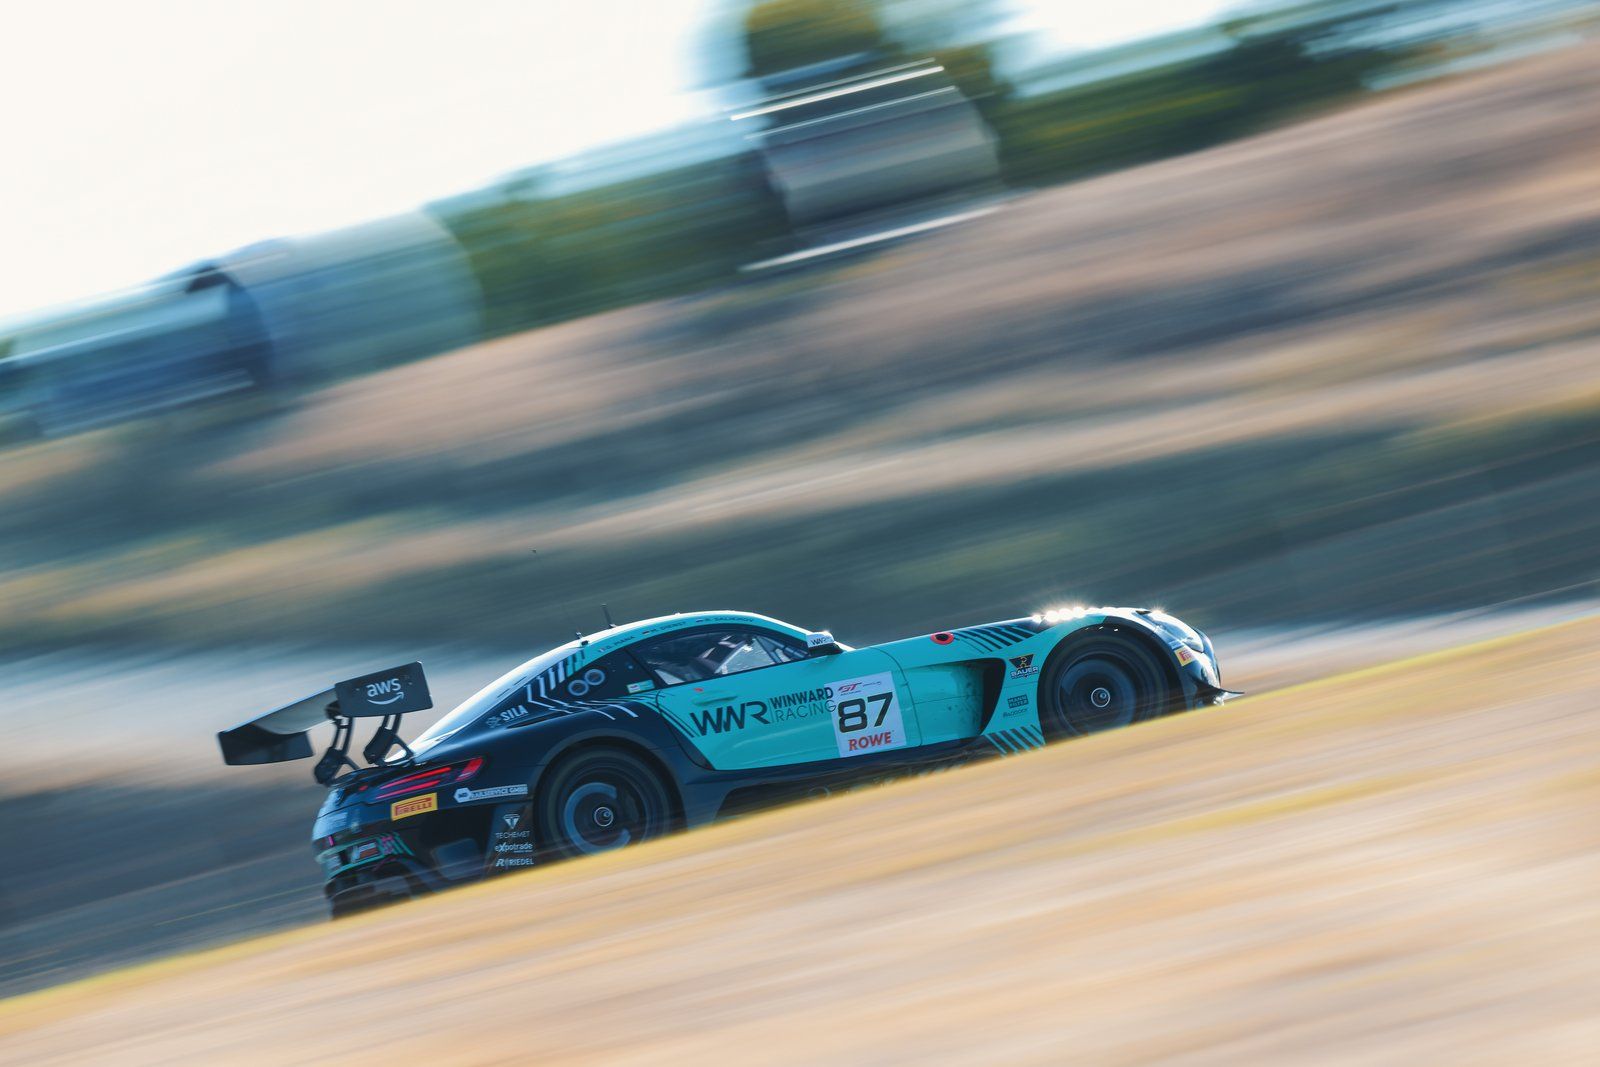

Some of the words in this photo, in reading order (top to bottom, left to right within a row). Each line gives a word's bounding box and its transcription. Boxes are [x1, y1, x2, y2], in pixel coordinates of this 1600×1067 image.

[1011, 667, 1038, 677] BAUER
[366, 678, 401, 697] aws
[770, 687, 834, 709] WINWARD
[501, 705, 528, 722] SILA
[775, 699, 837, 723] RACING
[838, 692, 893, 733] 87
[848, 732, 892, 751] ROWE
[395, 797, 432, 816] PIRELLI
[495, 831, 530, 839] TECHEMET
[509, 858, 534, 867] RIEDEL
